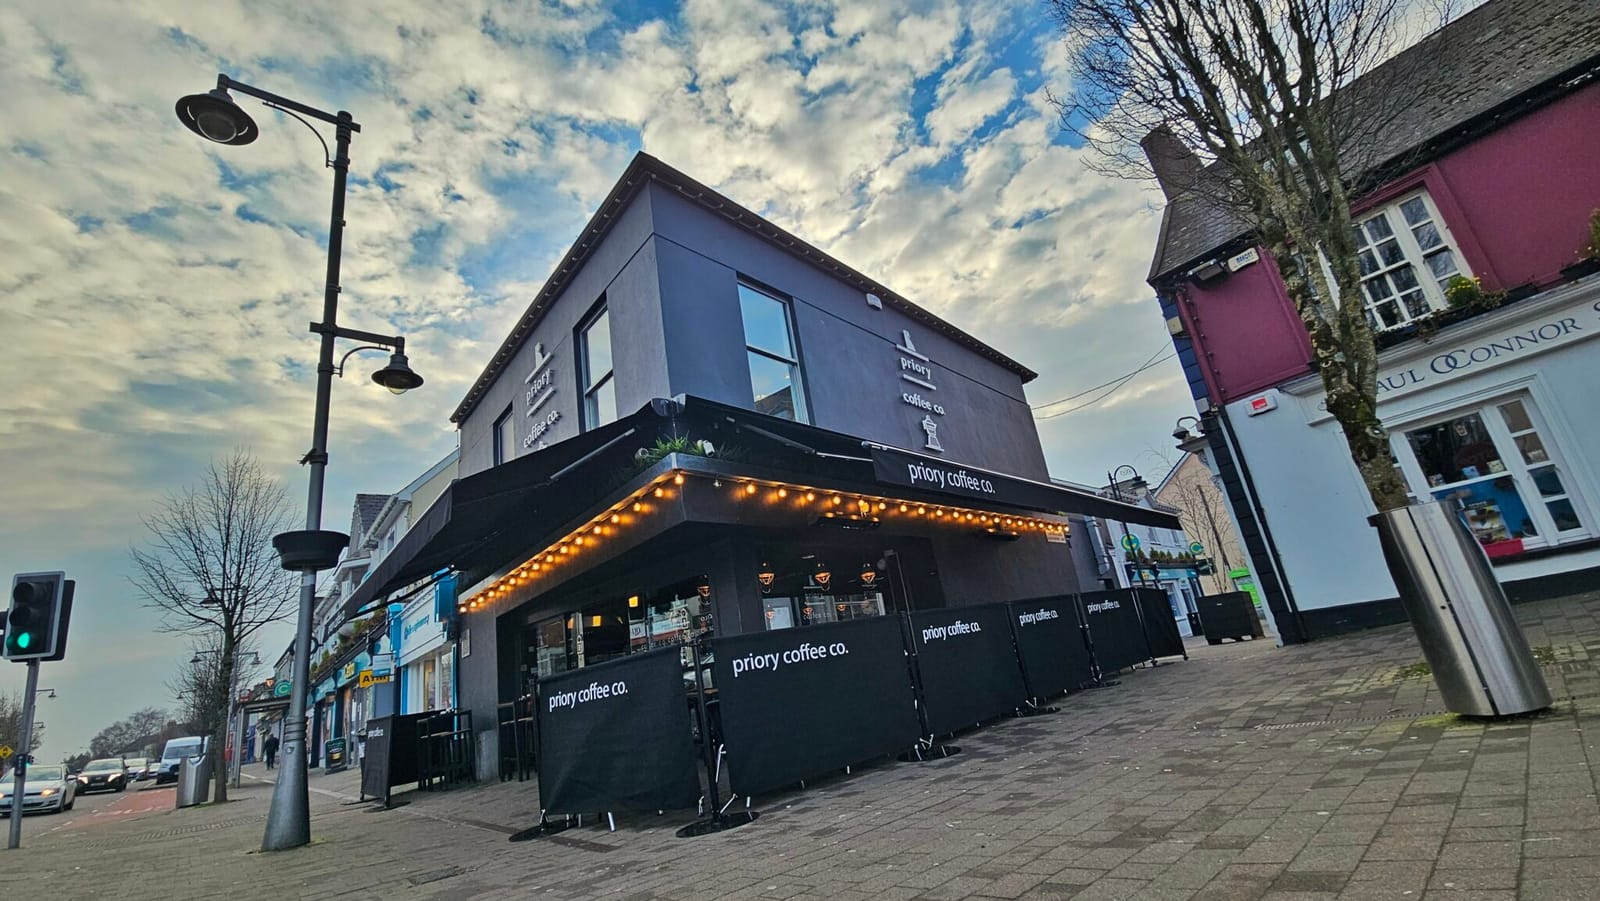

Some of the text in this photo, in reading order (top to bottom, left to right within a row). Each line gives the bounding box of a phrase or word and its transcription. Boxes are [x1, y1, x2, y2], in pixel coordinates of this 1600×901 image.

[901, 357, 931, 380] priory
[1376, 368, 1425, 395] AUL
[526, 368, 551, 406] priory
[903, 393, 932, 411] coffee
[523, 421, 546, 449] coffee
[907, 461, 996, 494] priory coffee co.
[1019, 611, 1036, 627] priory
[1035, 608, 1051, 621] coffee
[922, 624, 947, 645] priory
[947, 619, 970, 636] coffee
[732, 642, 849, 678] priory coffee co.
[549, 681, 629, 713] priory coffee co.
